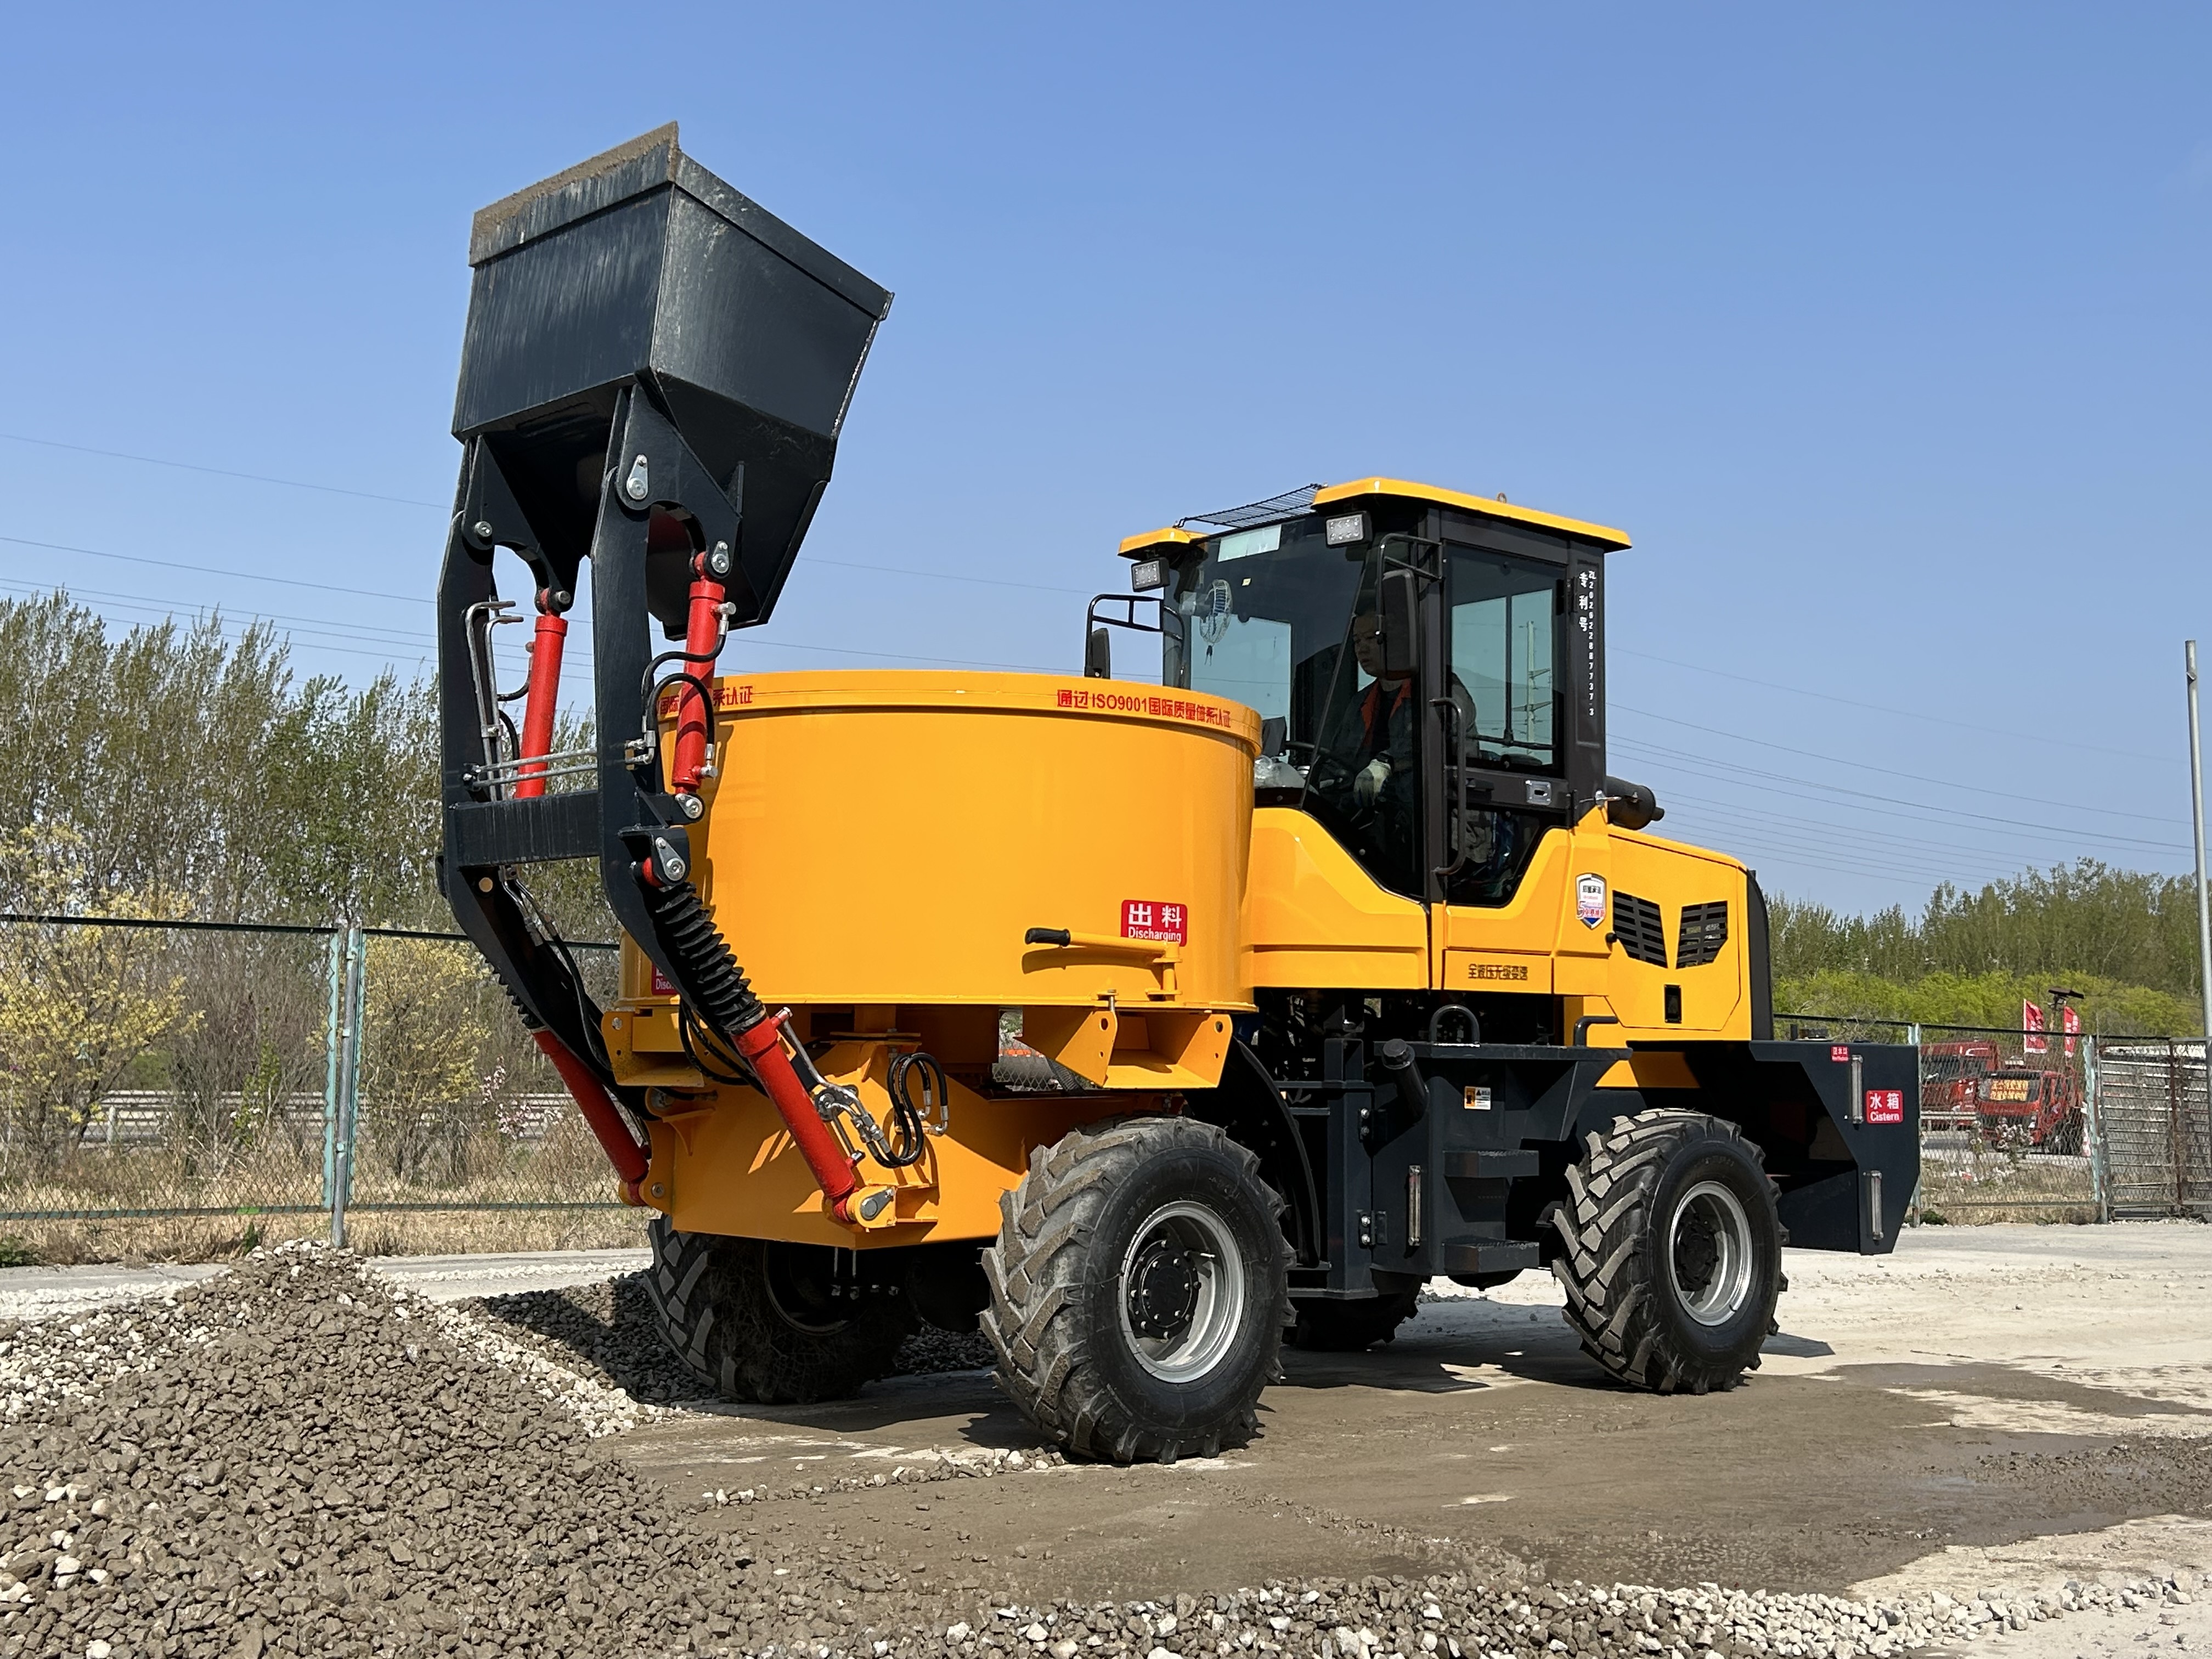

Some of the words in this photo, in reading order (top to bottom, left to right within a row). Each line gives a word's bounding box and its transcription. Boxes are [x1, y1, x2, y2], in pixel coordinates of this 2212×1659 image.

[1128, 903, 1182, 929] 出料
[1128, 926, 1182, 943] Discharging
[1870, 1092, 1899, 1110] 水箱
[1870, 1110, 1900, 1122] Cistern
